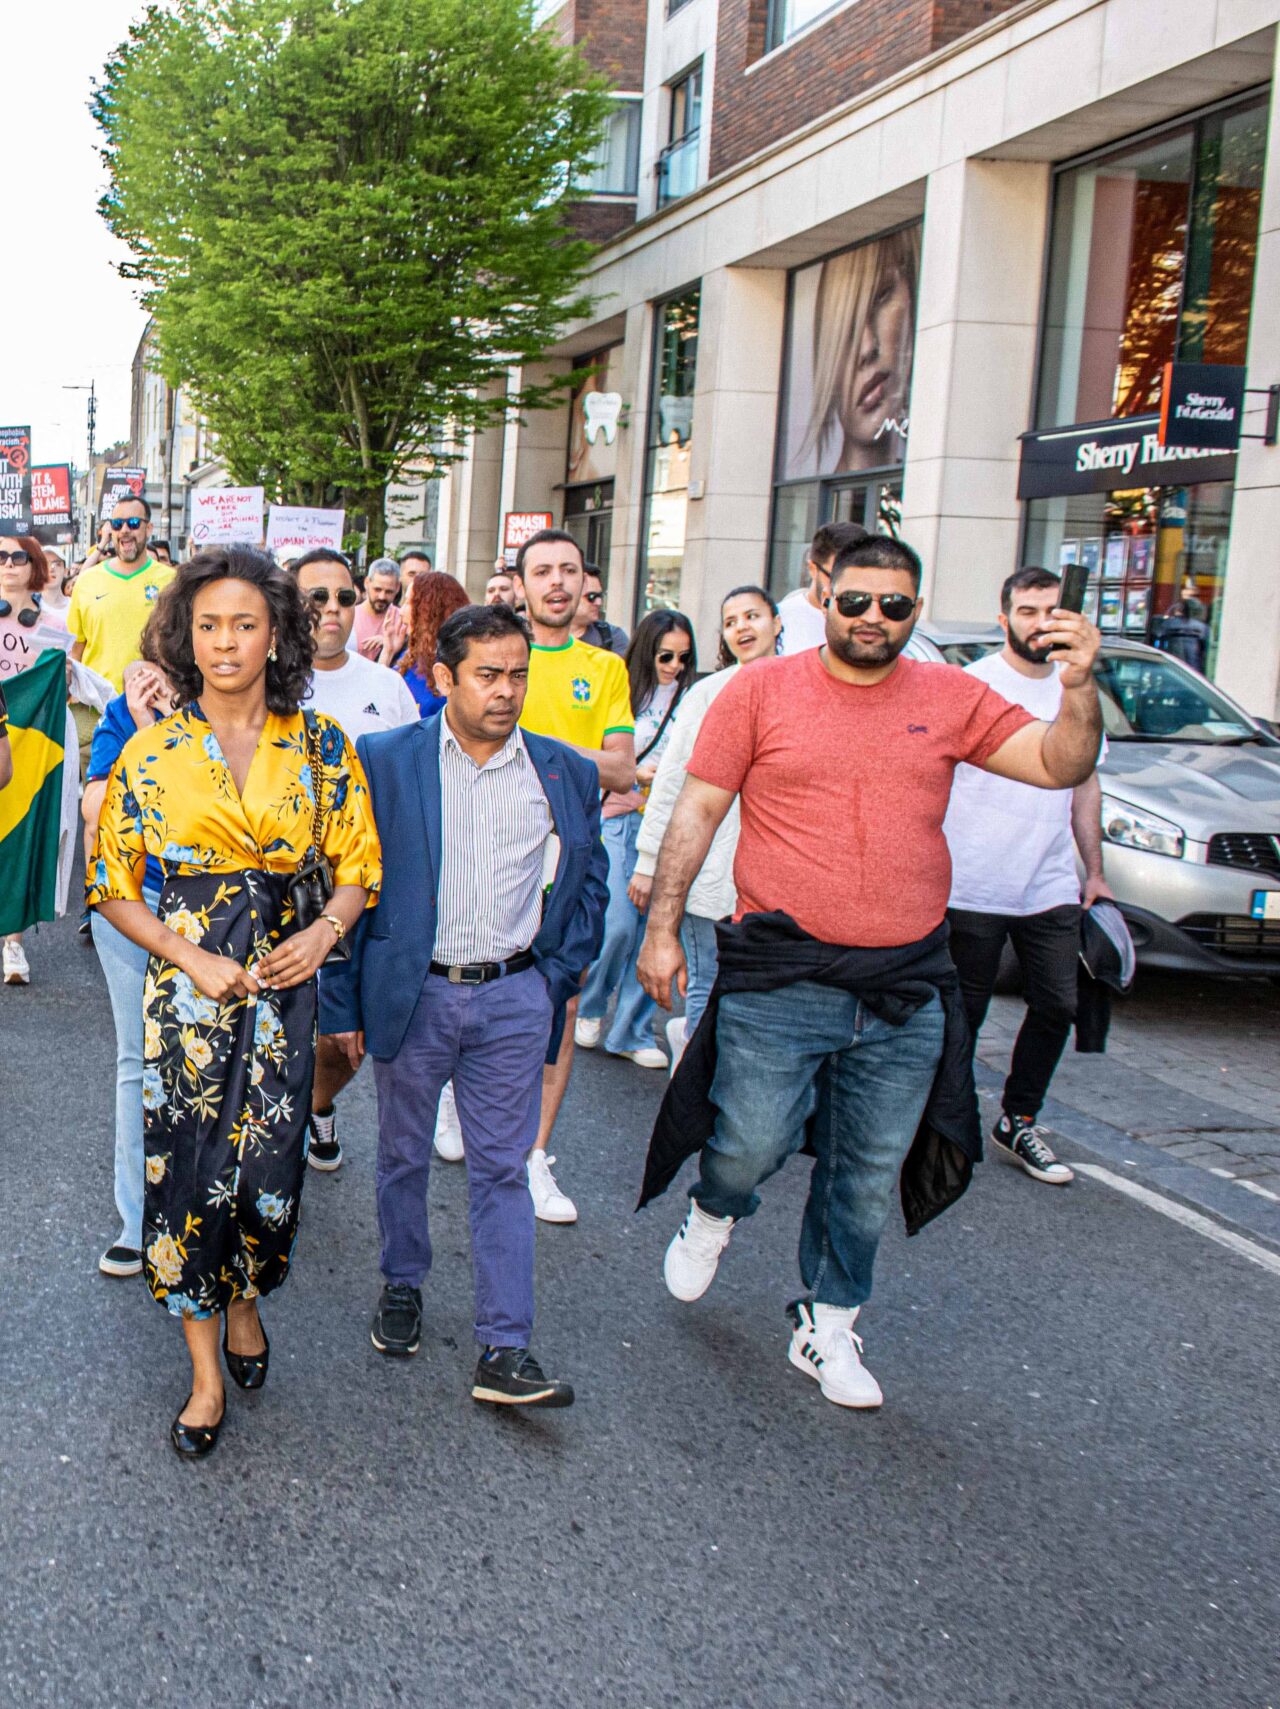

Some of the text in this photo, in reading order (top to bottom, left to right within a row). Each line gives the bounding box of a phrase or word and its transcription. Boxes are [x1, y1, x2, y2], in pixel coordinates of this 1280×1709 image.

[1186, 393, 1226, 409] Sherry
[1076, 442, 1139, 474] Sherry
[44, 473, 51, 484] &
[33, 497, 67, 511] BLAME.
[198, 496, 215, 505] WE
[237, 495, 252, 503] NOT
[33, 514, 70, 525] REFUGEES.
[508, 514, 547, 529] SMASH
